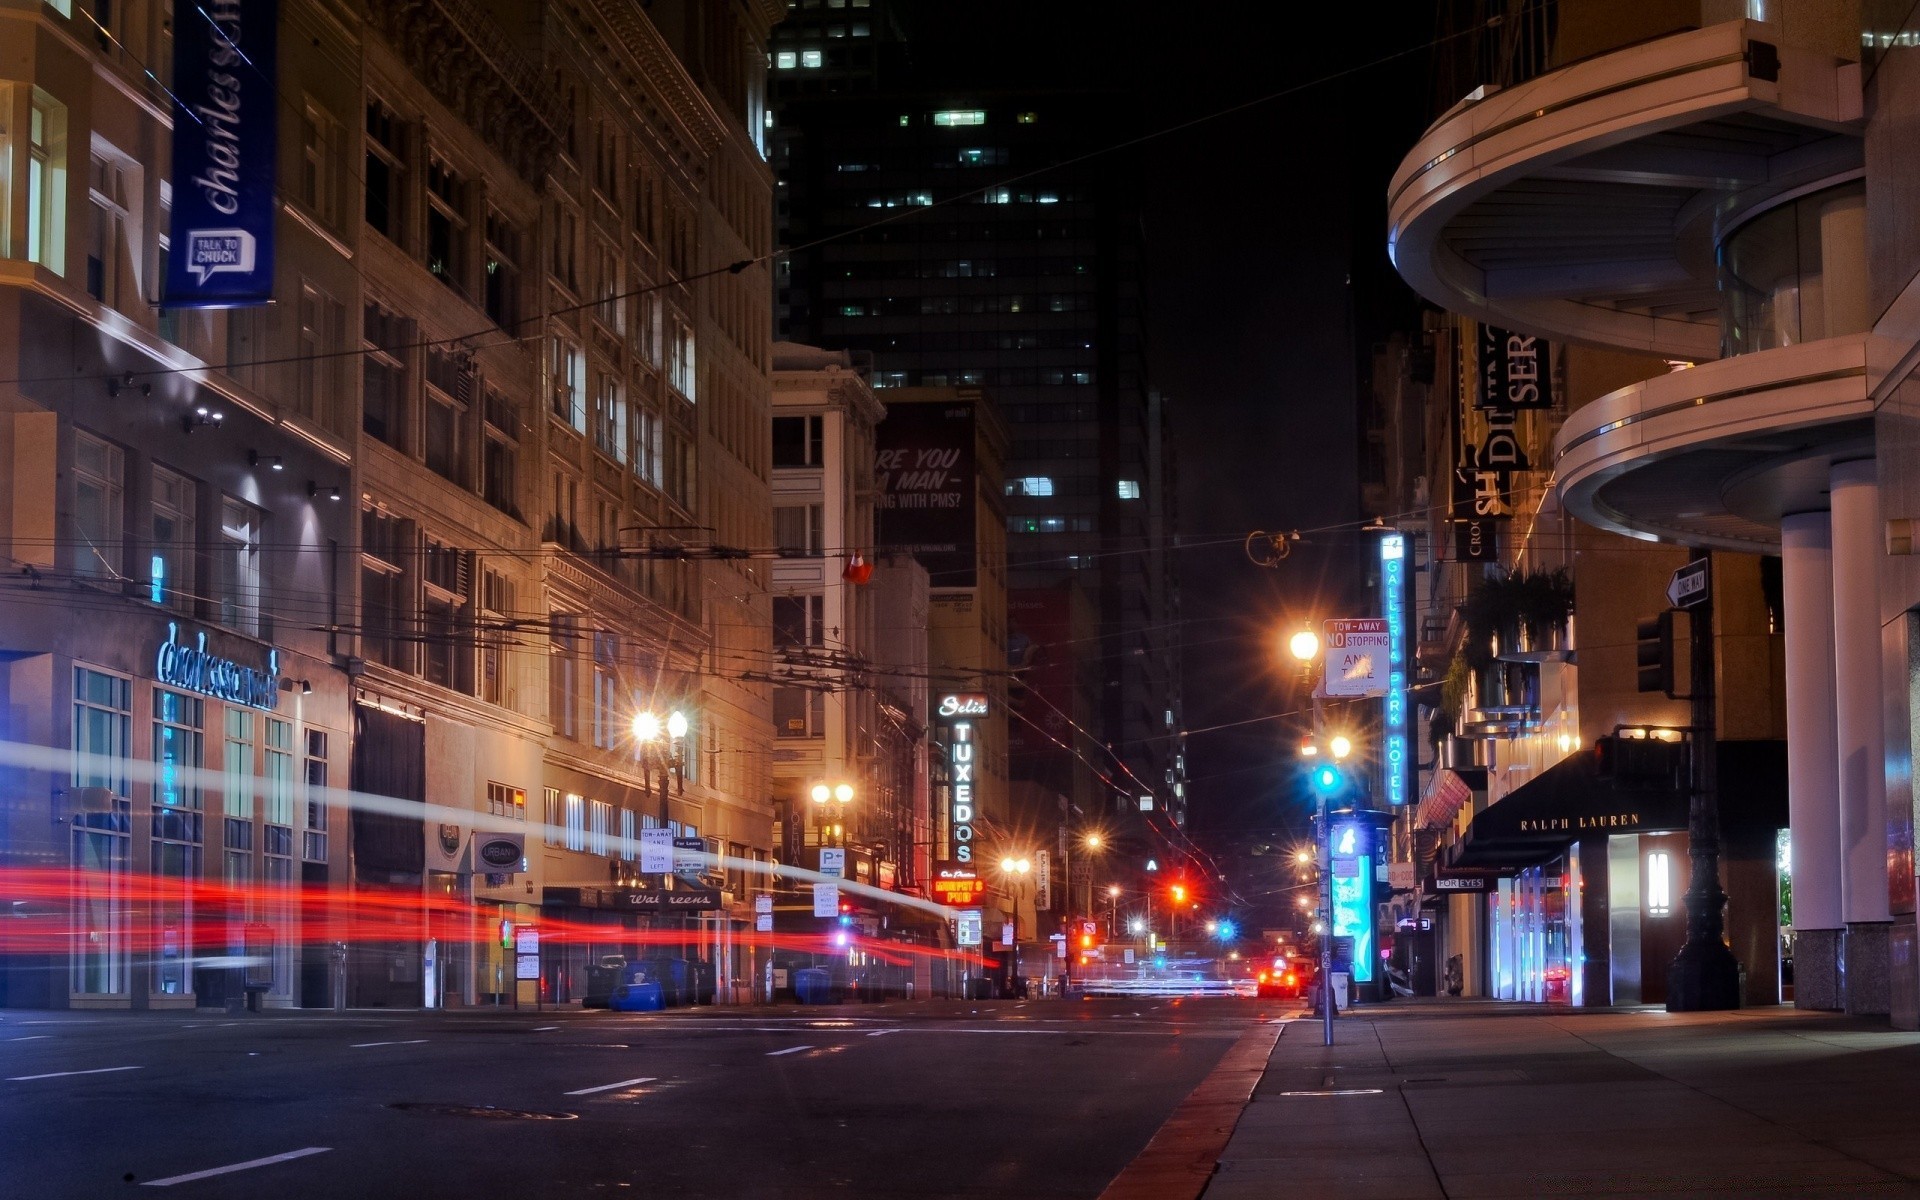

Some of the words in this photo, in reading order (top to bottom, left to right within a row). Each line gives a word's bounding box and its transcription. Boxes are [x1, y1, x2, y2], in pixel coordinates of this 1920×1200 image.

[198, 239, 221, 250] TALK
[225, 239, 238, 250] TO
[197, 250, 237, 263] CHUCK
[875, 448, 908, 470] RE
[915, 448, 961, 470] YOU
[895, 470, 947, 491] MAN
[899, 493, 926, 508] WITH
[930, 493, 961, 507] PMS?
[1678, 578, 1690, 596] ONE
[1691, 571, 1704, 591] WAY
[1387, 561, 1400, 660] GALLERIA
[1333, 622, 1381, 632] TOW-AWAY
[1326, 632, 1344, 647] NO
[1347, 635, 1388, 647] STOPPING
[1341, 668, 1374, 679] TE
[939, 696, 987, 716] Selix
[1389, 674, 1400, 724] PARK
[1389, 738, 1401, 801] HOTEL
[954, 723, 972, 862] TUXEDOS
[1521, 818, 1568, 831] RALPH
[1579, 813, 1639, 828] LAUREN
[935, 881, 983, 891] MURPHYS
[1439, 879, 1458, 888] FOR
[1460, 879, 1482, 888] EYES
[629, 894, 711, 905] Walreens
[947, 891, 971, 902] PUB
